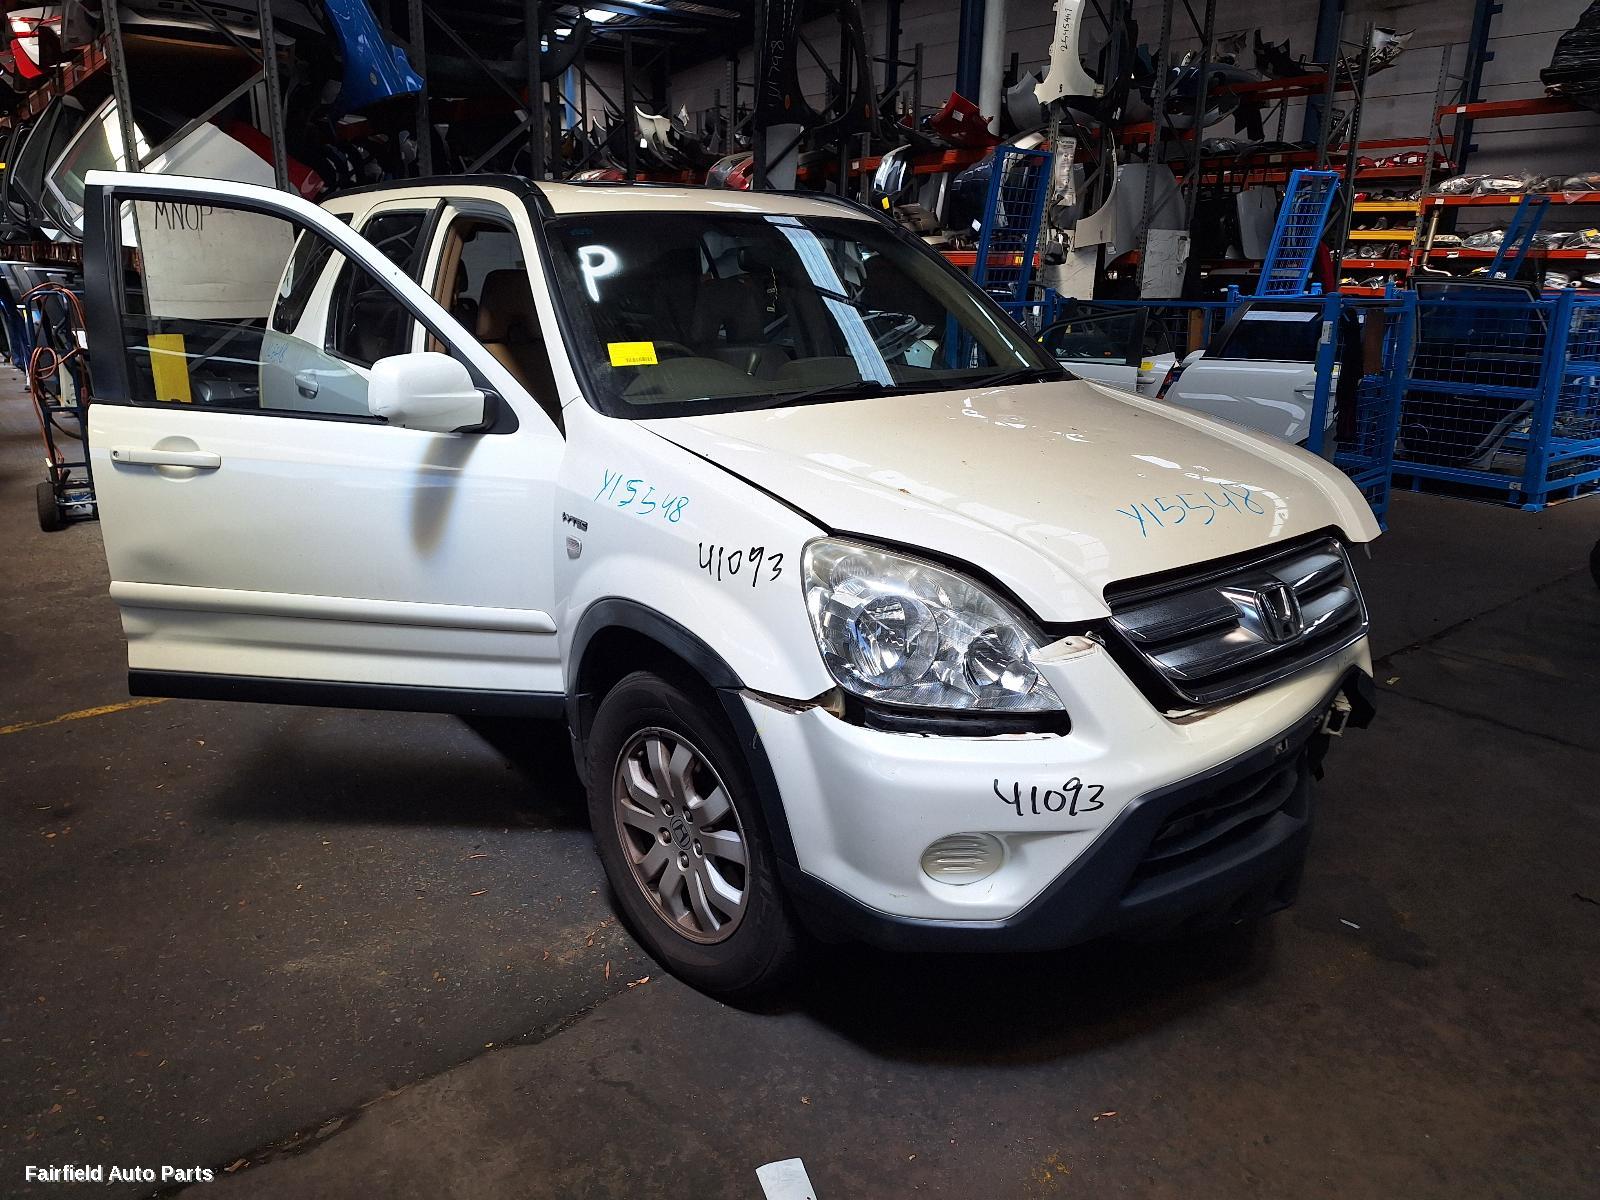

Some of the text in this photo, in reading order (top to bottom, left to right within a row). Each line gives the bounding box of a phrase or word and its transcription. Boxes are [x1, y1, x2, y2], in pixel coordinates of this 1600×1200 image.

[154, 201, 213, 231] MNOP
[578, 245, 619, 302] P
[594, 469, 690, 523] Y15548
[1116, 482, 1264, 538] Y15548
[699, 542, 784, 587] 41093
[993, 776, 1105, 816] 41093
